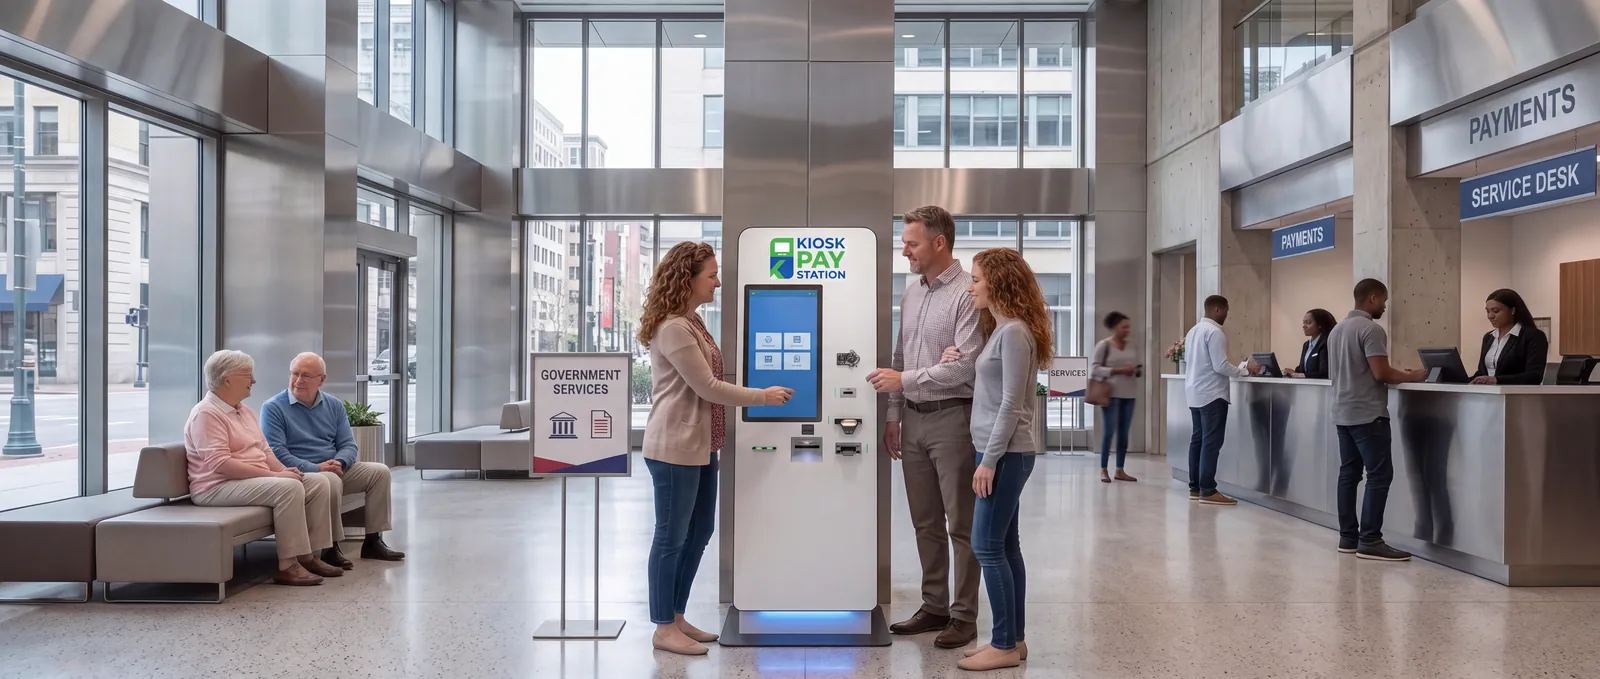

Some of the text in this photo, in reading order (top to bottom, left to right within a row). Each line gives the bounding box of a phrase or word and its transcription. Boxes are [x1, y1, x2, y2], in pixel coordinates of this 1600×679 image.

[1469, 83, 1576, 144] PAYMENTS
[1471, 163, 1579, 208] SERVICE DESK
[797, 237, 845, 249] KIOSK
[1281, 226, 1324, 250] PAYMENTS
[797, 251, 845, 268] PAY
[797, 270, 846, 279] STATION
[541, 369, 621, 380] GOVERNMENT
[553, 384, 609, 395] SERVICES
